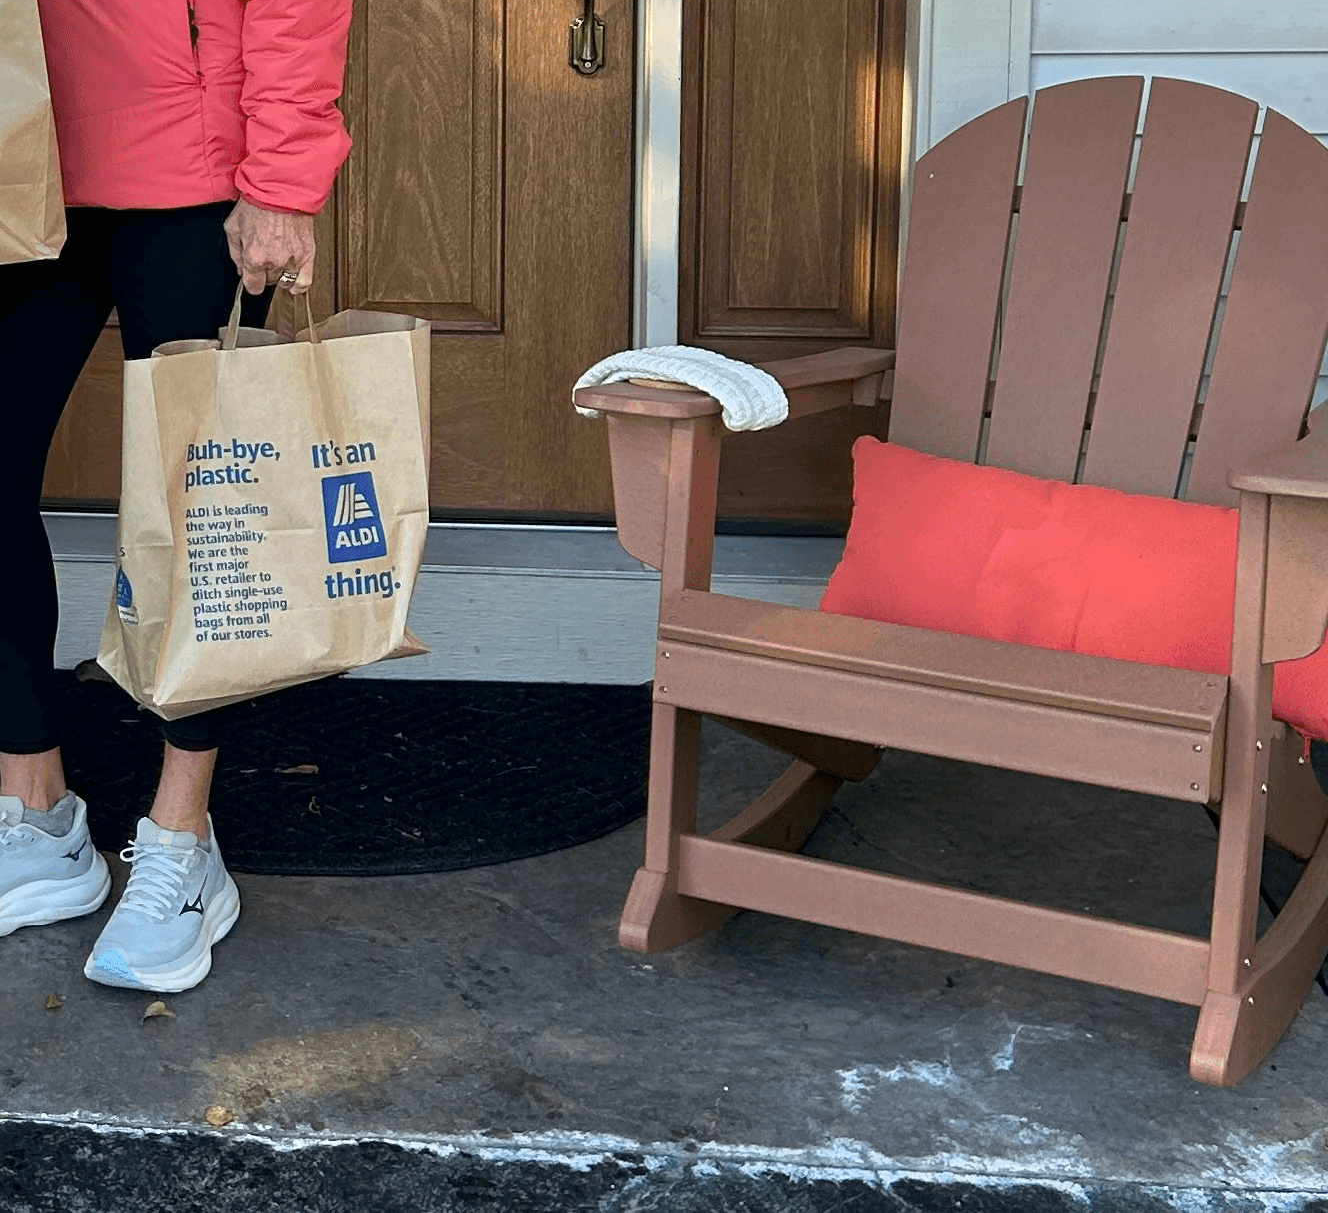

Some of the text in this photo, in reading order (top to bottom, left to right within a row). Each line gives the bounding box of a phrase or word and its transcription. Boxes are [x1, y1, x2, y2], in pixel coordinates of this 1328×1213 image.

[187, 438, 281, 464] Buh-bye,
[311, 439, 376, 469] It's an
[185, 462, 260, 493] plastic.
[185, 503, 269, 519] ALDI is leading
[185, 517, 246, 532] the way in
[186, 529, 267, 546] sustainability.
[335, 525, 380, 549] ALDI
[187, 545, 249, 560] We are the
[189, 558, 250, 573] first major
[190, 571, 272, 587] U.S. retailer to
[192, 586, 284, 600] ditch single-use
[193, 598, 288, 617] plastic shopping
[194, 612, 271, 631] bags from all
[195, 629, 273, 642] of our stores.
